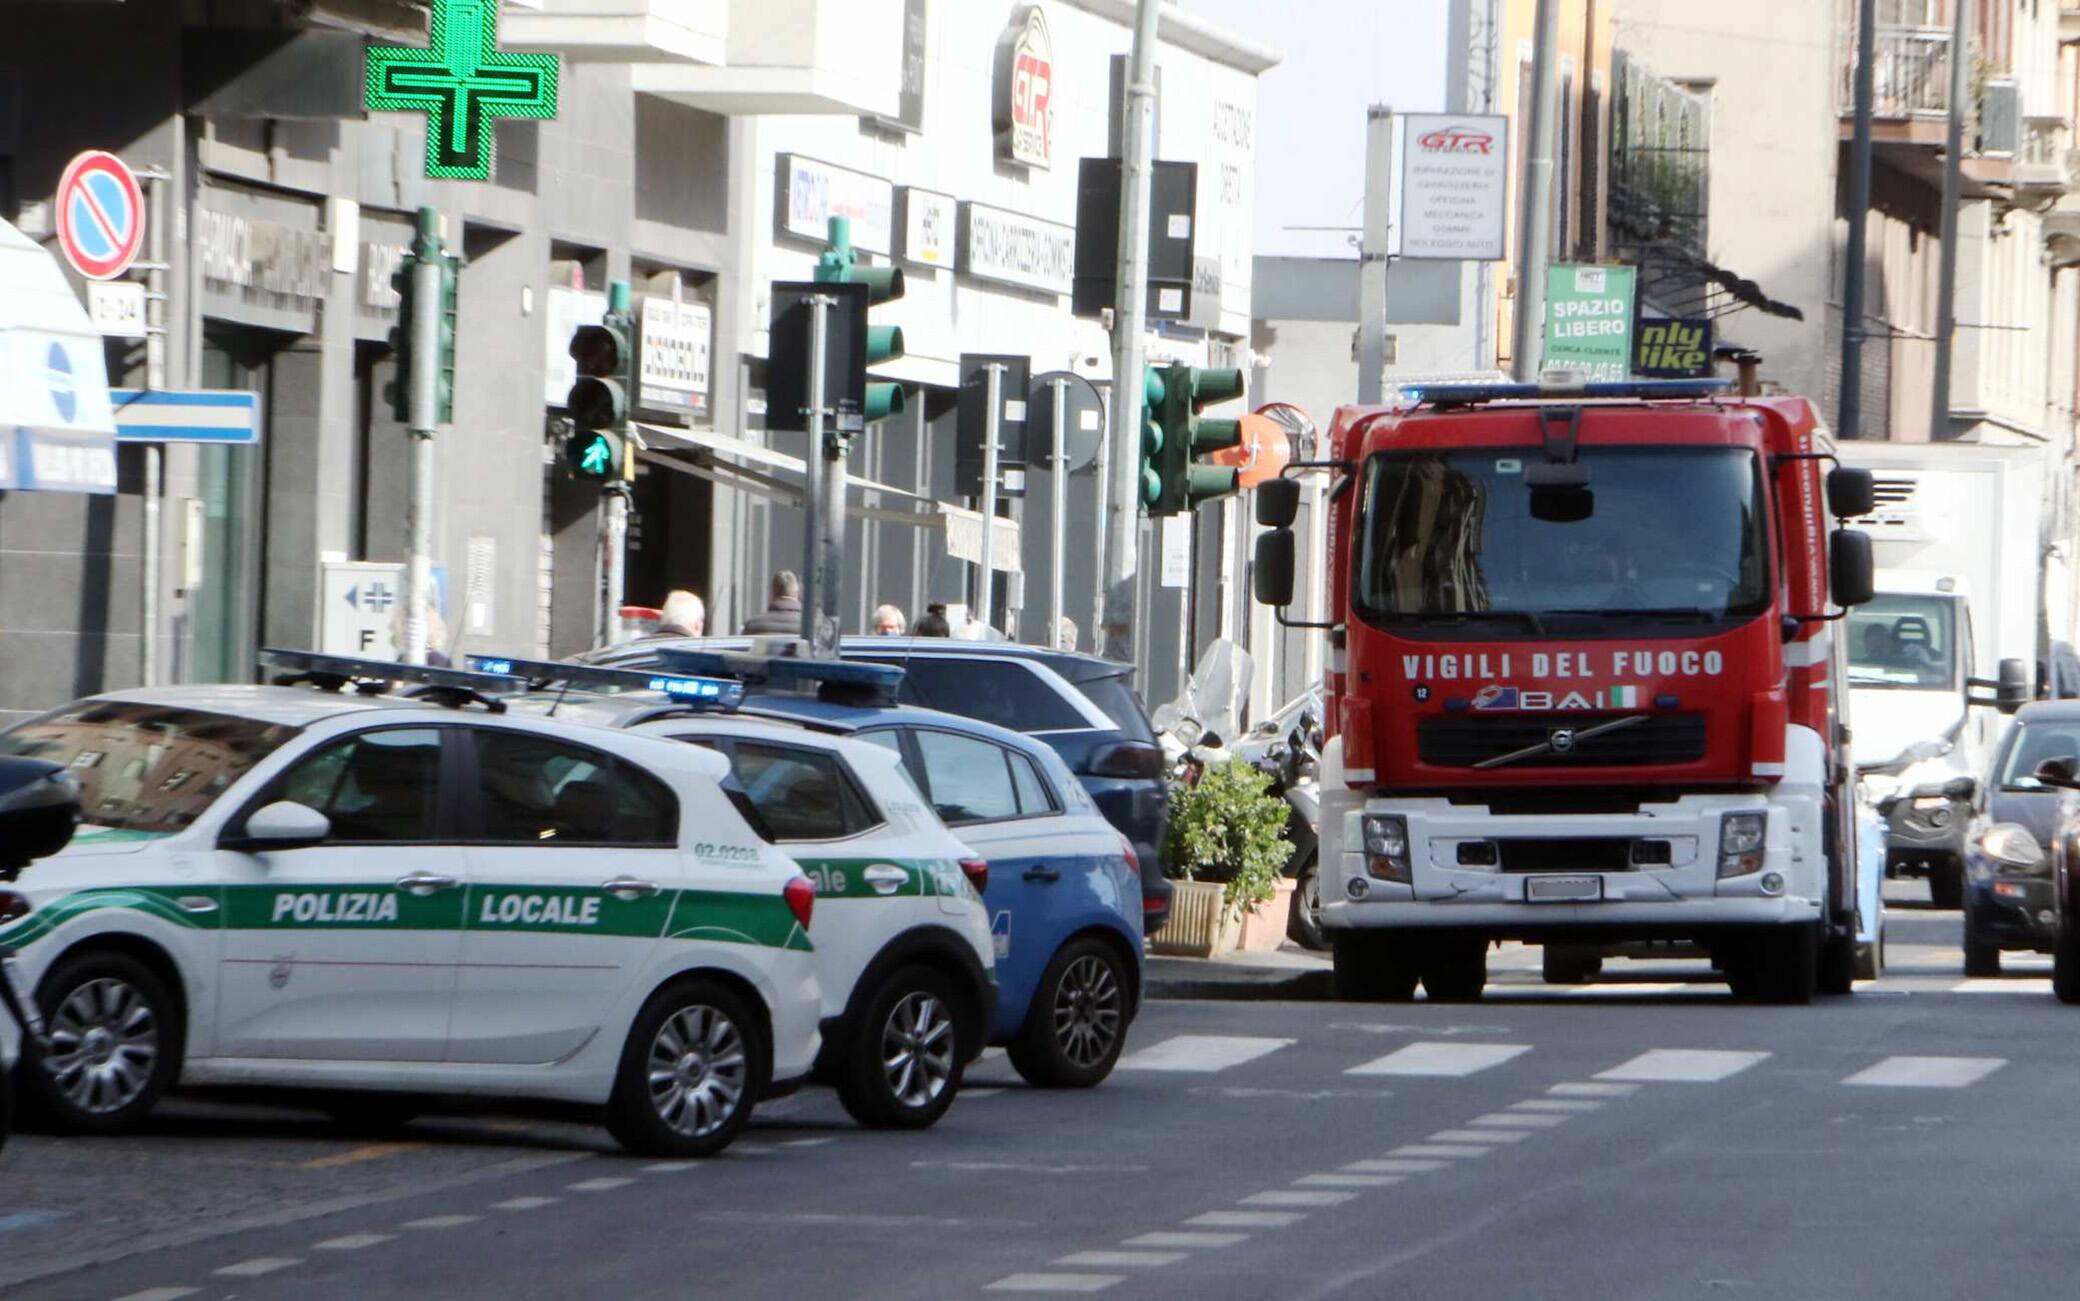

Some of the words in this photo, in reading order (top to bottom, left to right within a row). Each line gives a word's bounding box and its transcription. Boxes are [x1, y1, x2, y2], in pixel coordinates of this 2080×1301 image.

[1421, 131, 1494, 155] GTR
[1553, 299, 1624, 318] SPAZIO
[1554, 319, 1625, 338] LIBERO
[359, 629, 377, 651] F
[1402, 654, 1511, 680] VIGILI
[1532, 653, 1594, 678] DEL
[1612, 650, 1723, 677] FUOCO
[1416, 687, 1428, 699] 12
[1519, 691, 1604, 711] BAI
[272, 893, 398, 922] POLIZIA
[480, 894, 602, 924] LOCALE
